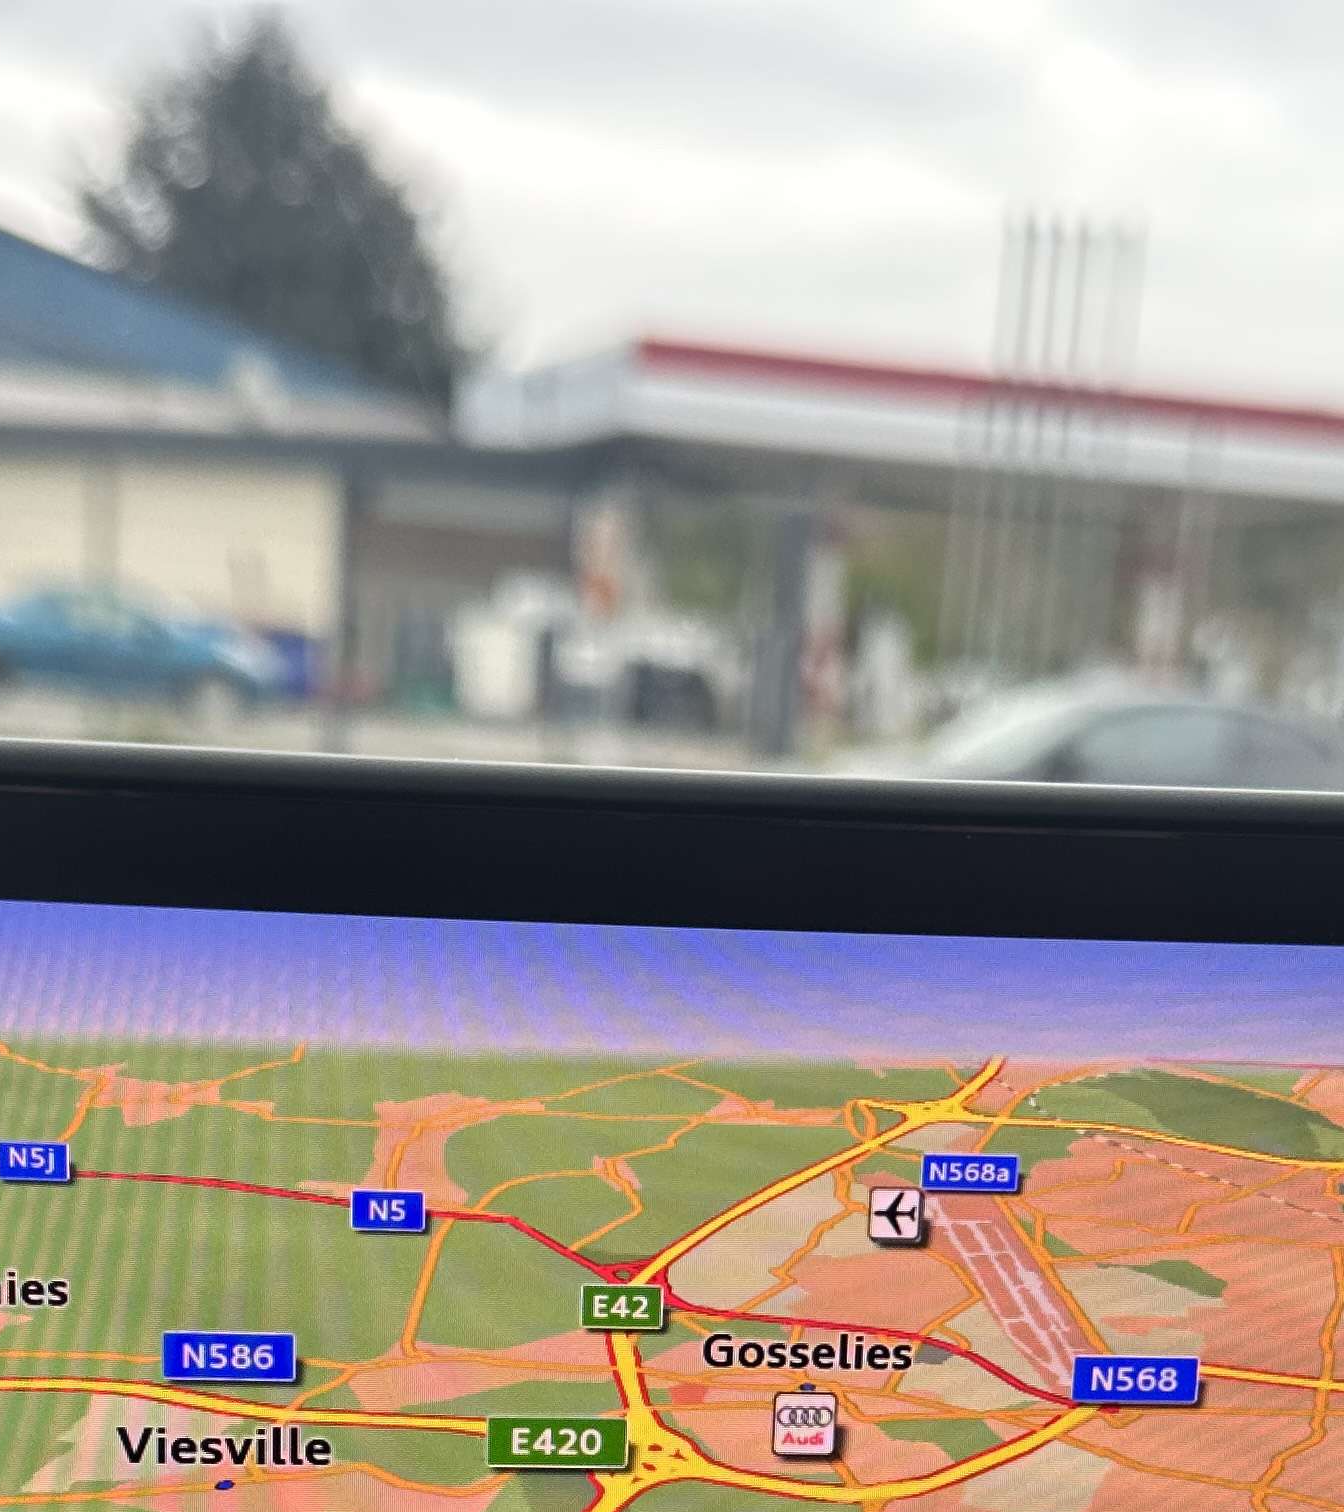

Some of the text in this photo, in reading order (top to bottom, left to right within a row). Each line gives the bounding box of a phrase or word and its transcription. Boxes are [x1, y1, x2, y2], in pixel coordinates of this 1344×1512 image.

[8, 1147, 56, 1175] N5j
[928, 1161, 1011, 1183] N568a
[368, 1198, 406, 1222] N5
[592, 1294, 651, 1320] E42
[181, 1342, 274, 1370] N586
[702, 1333, 914, 1371] Gosselies
[1090, 1365, 1178, 1392] N568
[116, 1426, 333, 1466] Viesville
[510, 1427, 604, 1456] E420
[782, 1431, 825, 1446] Audi
